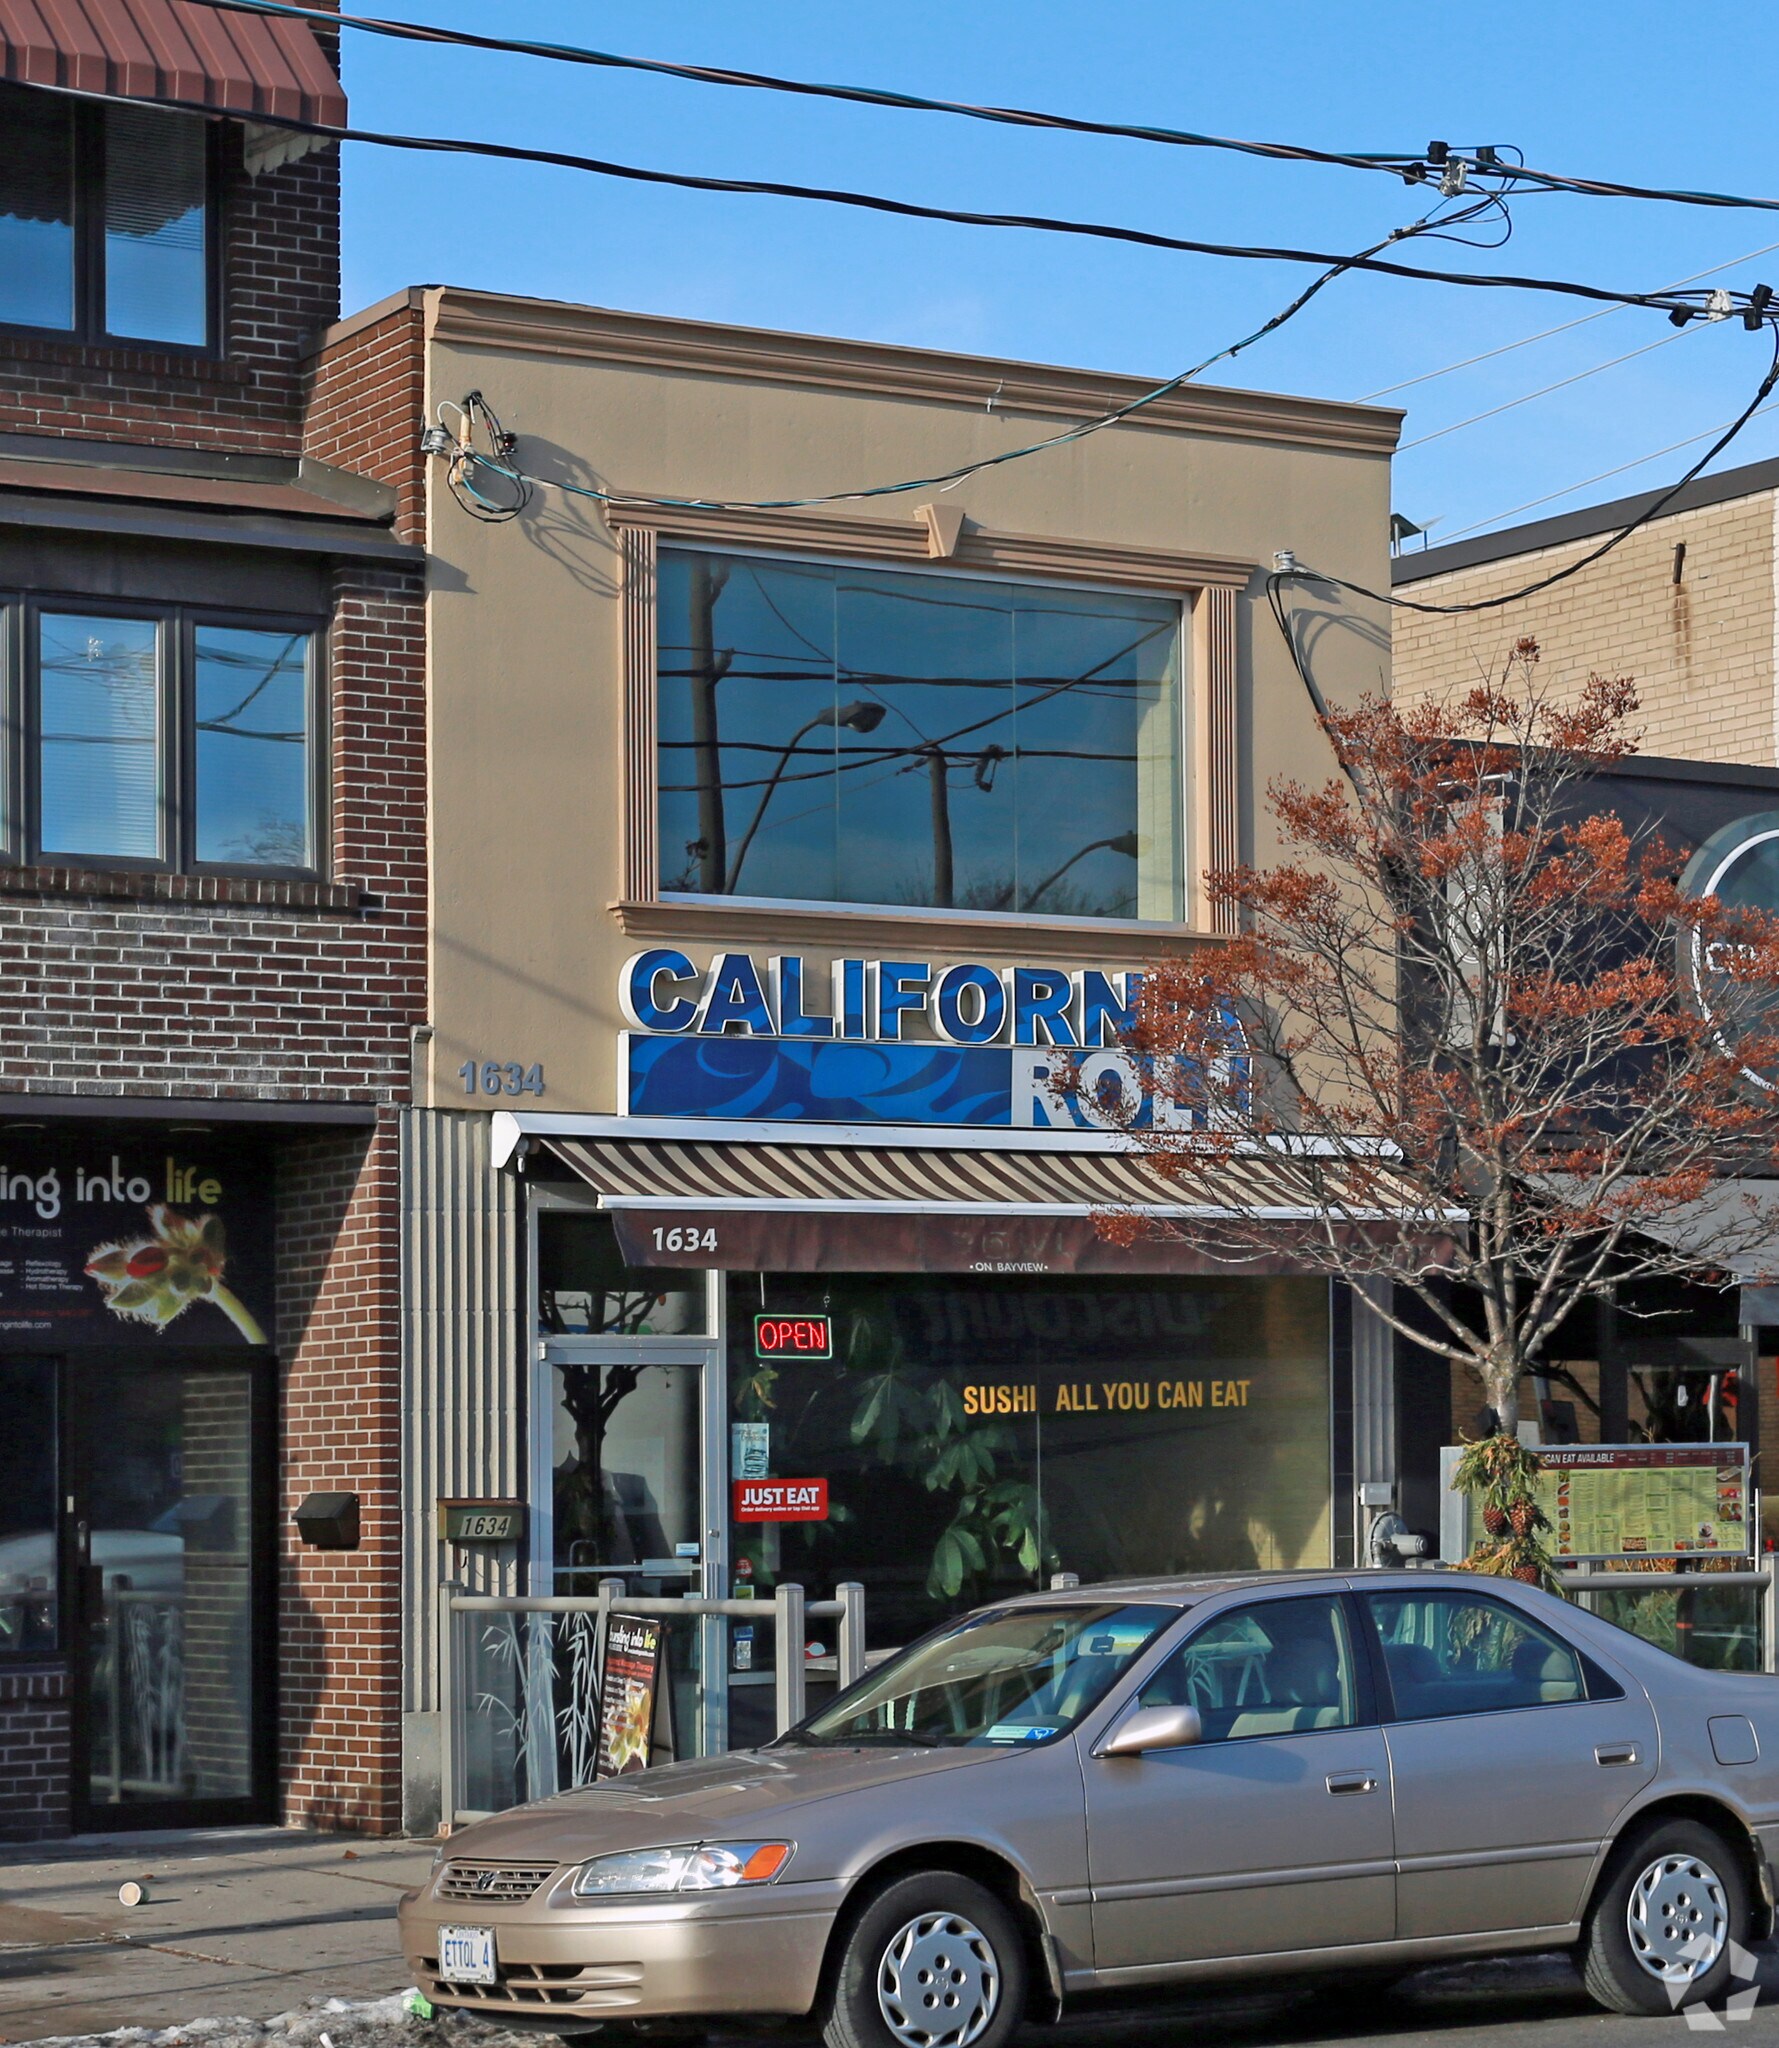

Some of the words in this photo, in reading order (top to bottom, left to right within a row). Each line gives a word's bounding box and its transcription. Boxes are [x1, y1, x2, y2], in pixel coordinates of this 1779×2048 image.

[618, 947, 1251, 1052] CALIFORNA
[458, 1059, 546, 1097] 1634
[76, 1155, 151, 1203] into
[166, 1157, 223, 1204] life
[11, 1227, 62, 1238] Therapist
[652, 1227, 718, 1252] 1634
[975, 1262, 993, 1272] ON
[997, 1262, 1044, 1272] BAYVIEW
[59, 1284, 84, 1292] Therapy
[760, 1321, 825, 1350] OPEN
[963, 1385, 1036, 1415] SUSHI
[1055, 1384, 1099, 1411] ALL
[1102, 1382, 1150, 1409] YOU
[1157, 1381, 1204, 1408] CAN
[1211, 1380, 1251, 1407] EAT
[1562, 1453, 1577, 1464] EAT
[1577, 1452, 1615, 1463] AVAILABLE
[741, 1487, 784, 1505] JUST
[787, 1487, 819, 1504] EAT
[463, 1516, 509, 1536] 1634
[643, 1629, 657, 1650] life
